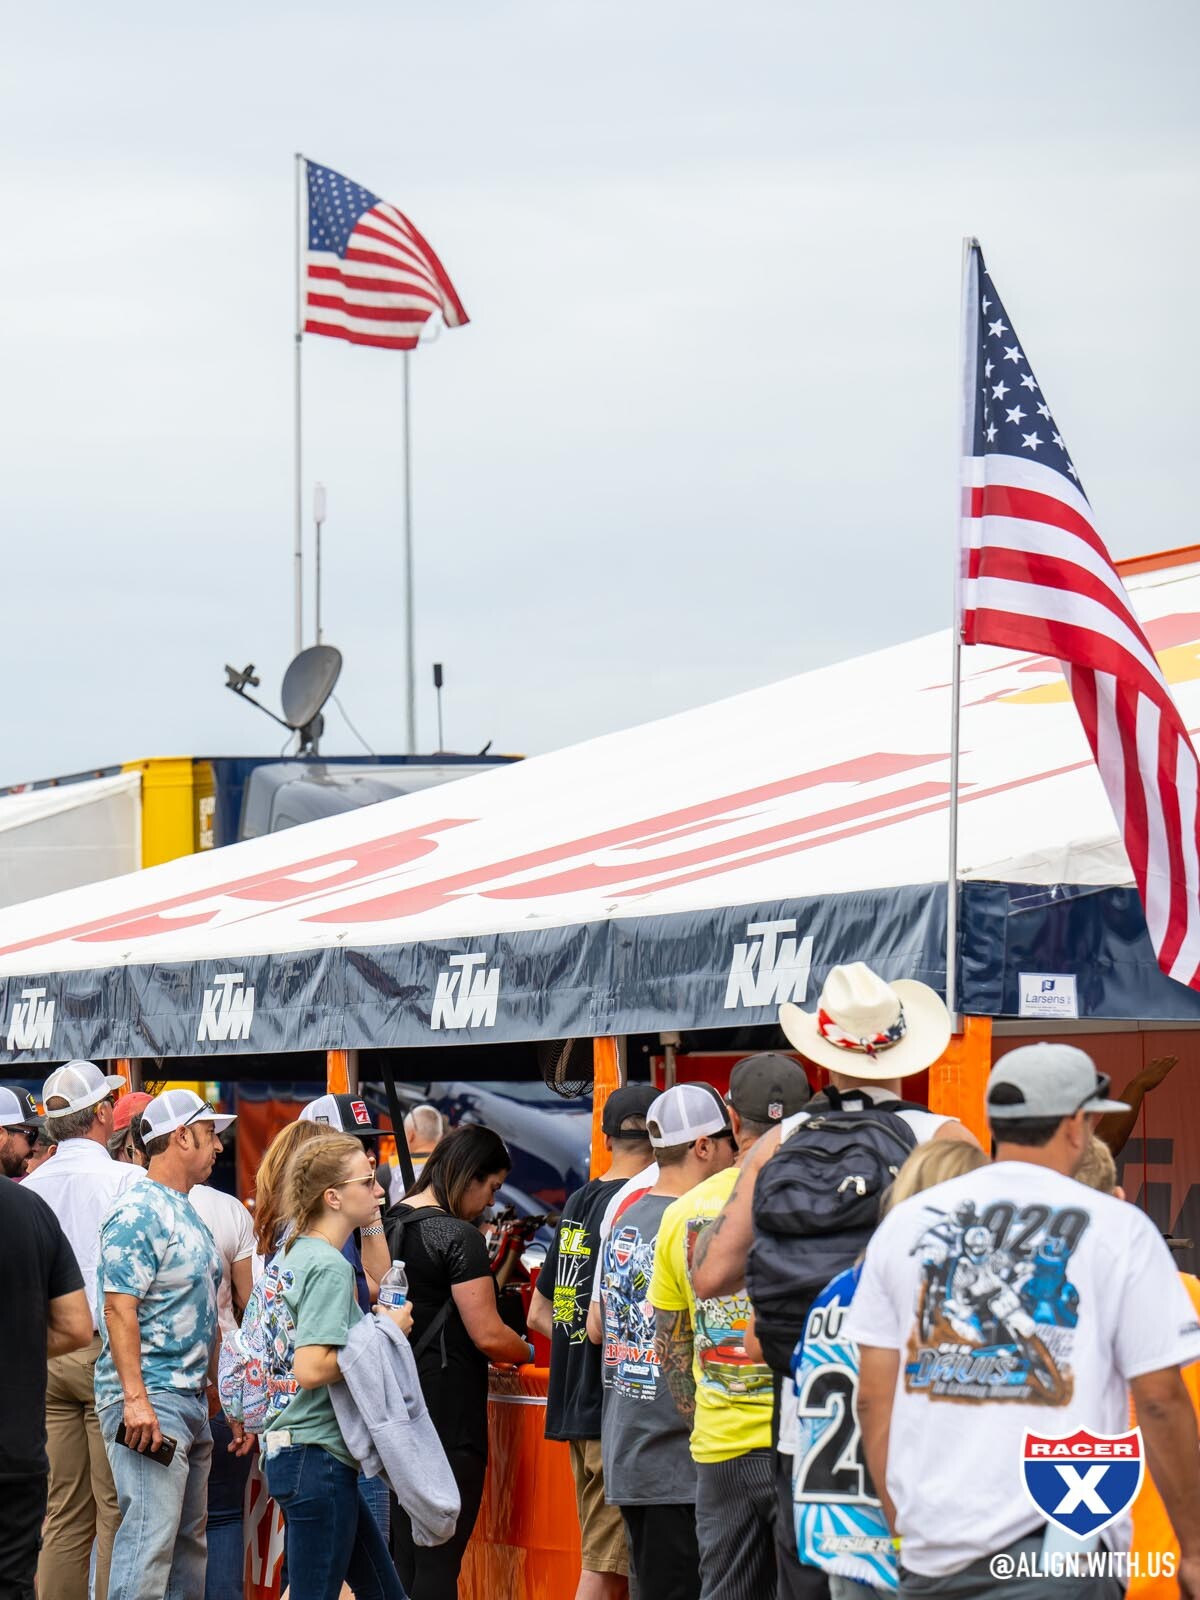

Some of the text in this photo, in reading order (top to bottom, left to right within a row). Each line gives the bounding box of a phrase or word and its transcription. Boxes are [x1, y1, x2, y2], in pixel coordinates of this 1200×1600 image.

[431, 952, 500, 1030] KTM
[724, 919, 814, 1008] KTM
[1025, 992, 1065, 1004] Larsens
[6, 988, 55, 1050] KTM
[197, 972, 255, 1041] KTM
[796, 1362, 882, 1506] 2
